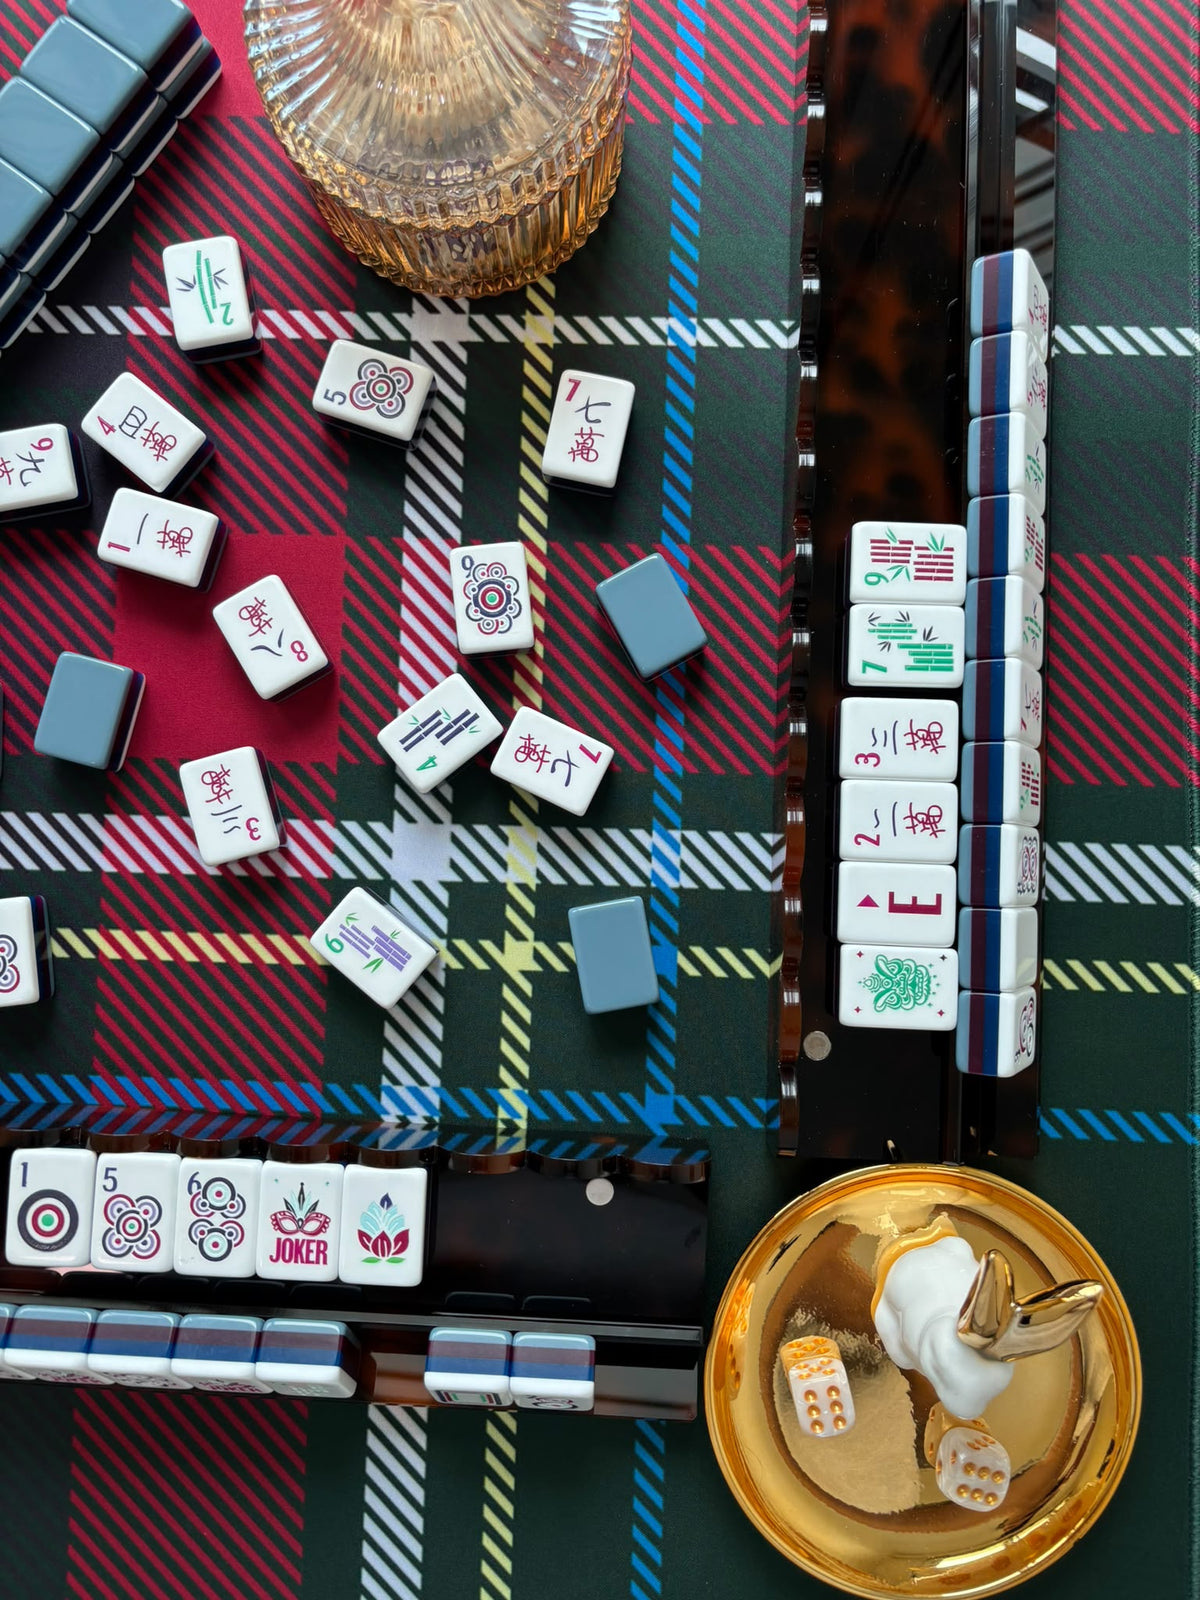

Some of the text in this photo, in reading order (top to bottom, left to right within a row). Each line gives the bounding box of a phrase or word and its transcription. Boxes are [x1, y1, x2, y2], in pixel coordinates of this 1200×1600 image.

[221, 303, 234, 326] 2
[323, 389, 347, 406] 5
[566, 378, 581, 402] 7
[97, 416, 117, 436] 4
[31, 437, 54, 452] 9
[107, 541, 131, 553] 1
[461, 555, 475, 579] 9
[864, 571, 889, 586] 9
[290, 640, 309, 663] 8
[862, 660, 888, 674] 7
[415, 755, 438, 772] 4
[579, 743, 602, 764] 7
[855, 752, 881, 767] 3
[246, 817, 261, 841] 3
[854, 833, 880, 846] 2
[888, 891, 942, 915] E
[324, 933, 345, 954] 6
[20, 1161, 28, 1188] 1
[102, 1167, 118, 1192] 5
[187, 1171, 201, 1196] 6
[269, 1237, 328, 1266] JOKER
